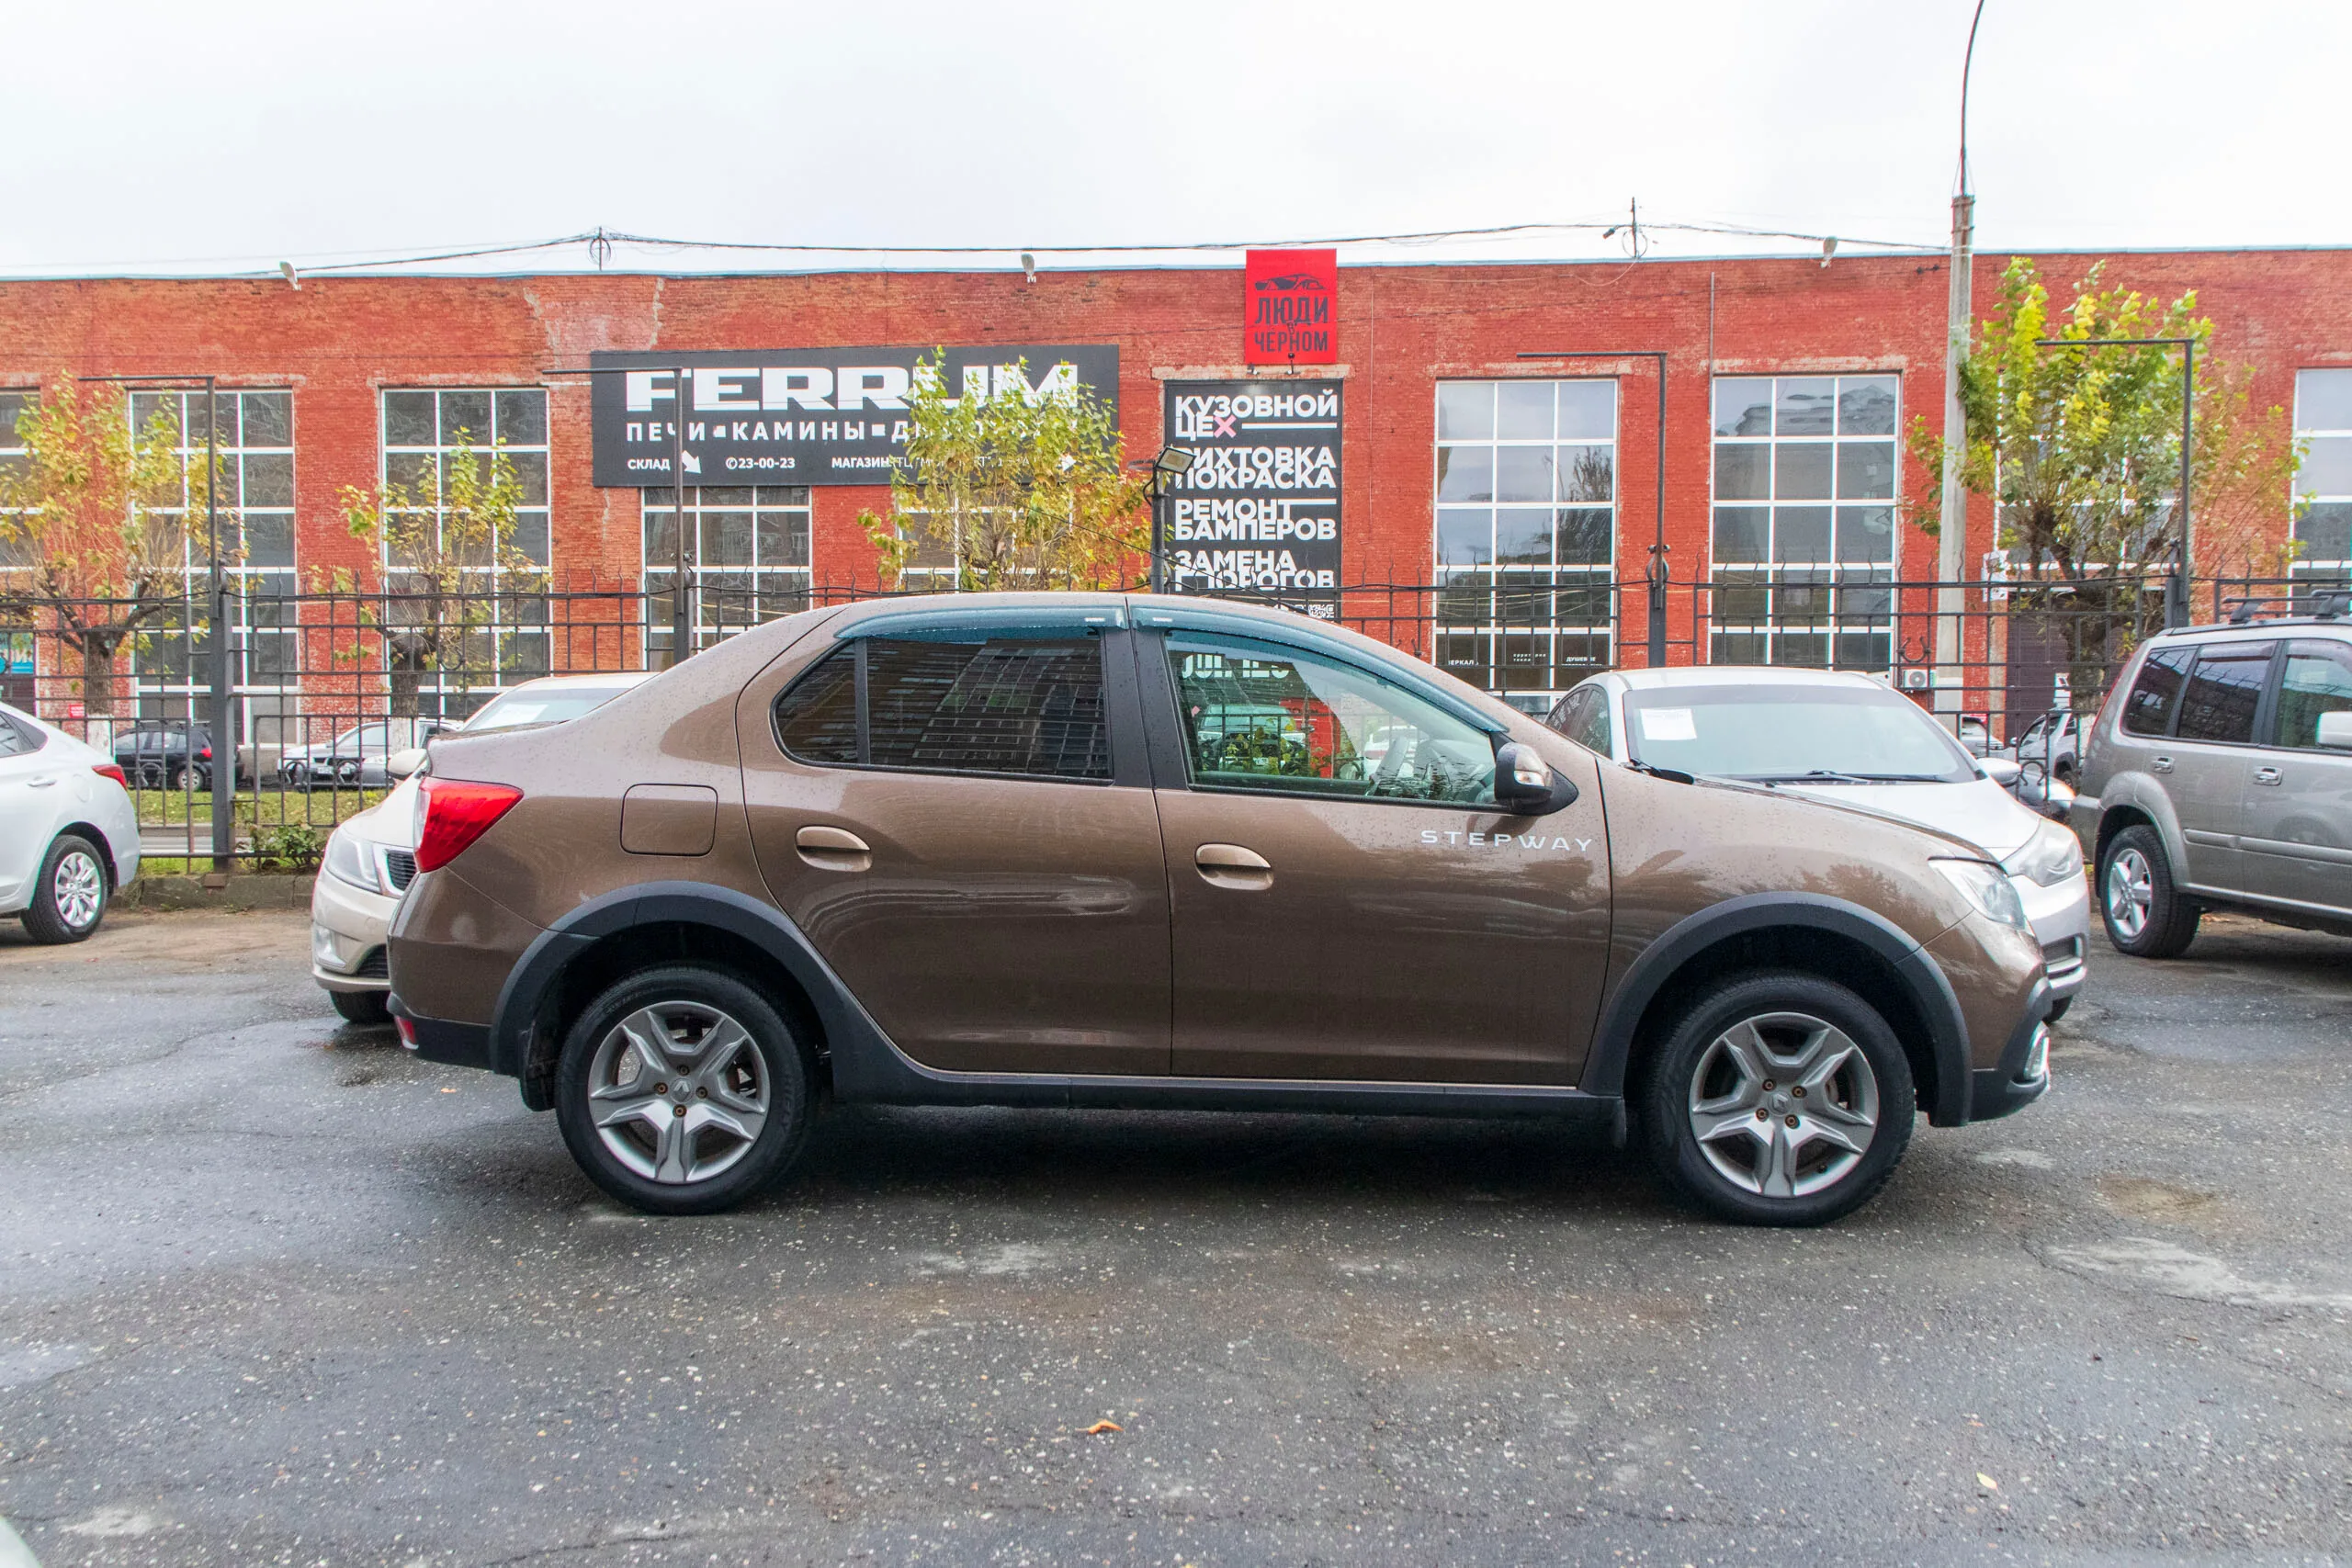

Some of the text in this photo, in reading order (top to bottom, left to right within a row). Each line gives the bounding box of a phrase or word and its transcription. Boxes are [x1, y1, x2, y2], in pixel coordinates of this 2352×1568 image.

[1254, 296, 1329, 326] ЛЮДИ
[1254, 331, 1329, 353] ЧЕРНОМ
[626, 364, 1078, 412] FERRUM
[1175, 389, 1338, 419] КУЗОВНОЙ
[732, 421, 865, 441] КАМИНЫ
[1175, 414, 1238, 442] ЦЕХ
[627, 458, 671, 471] СКЛАД
[1175, 446, 1337, 470] ИХТОВКА
[1175, 467, 1337, 490] ПОКРАСКА
[1175, 498, 1295, 521] РЕМОНТ
[1175, 518, 1337, 541] БАМПЕРОВ
[1175, 549, 1298, 573] ЗАМЕНА
[1175, 567, 1335, 592] ПОРОГОВ
[1420, 829, 1593, 852] STEPWAY
